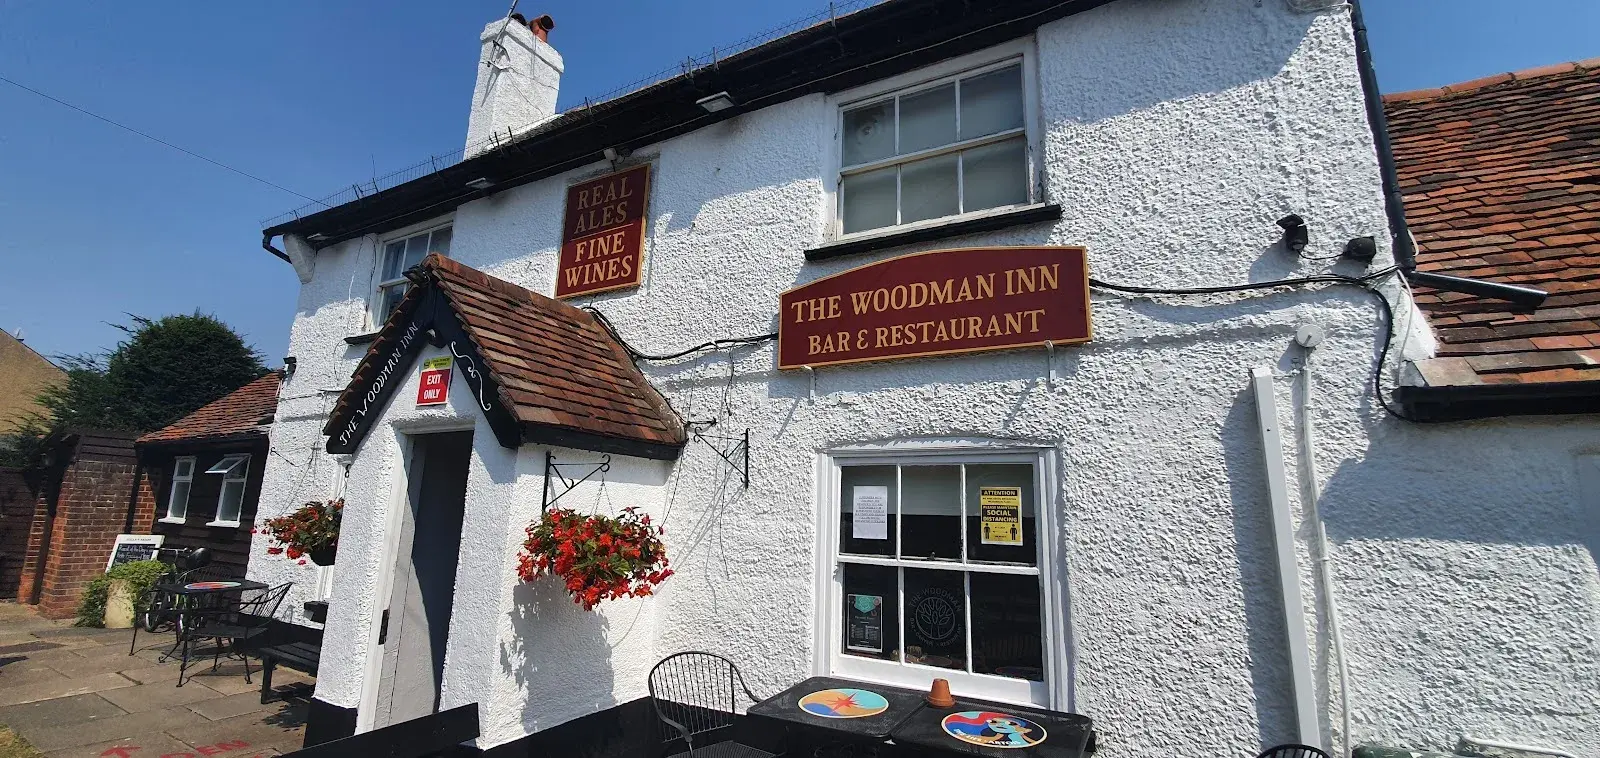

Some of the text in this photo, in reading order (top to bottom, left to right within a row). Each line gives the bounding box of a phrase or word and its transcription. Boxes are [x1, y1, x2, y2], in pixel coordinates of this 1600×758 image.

[577, 177, 633, 210] REAL
[574, 202, 628, 234] ALES
[575, 231, 626, 262] FINE
[564, 255, 633, 288] WINES
[791, 263, 1061, 324] THE WOODMAN INN
[808, 309, 1046, 355] BAR & RESTAURANT
[339, 321, 419, 446] THE WOODMAN INN
[423, 388, 441, 400] ONLY
[426, 373, 443, 386] EXIT
[909, 587, 963, 612] THE WOODMAN
